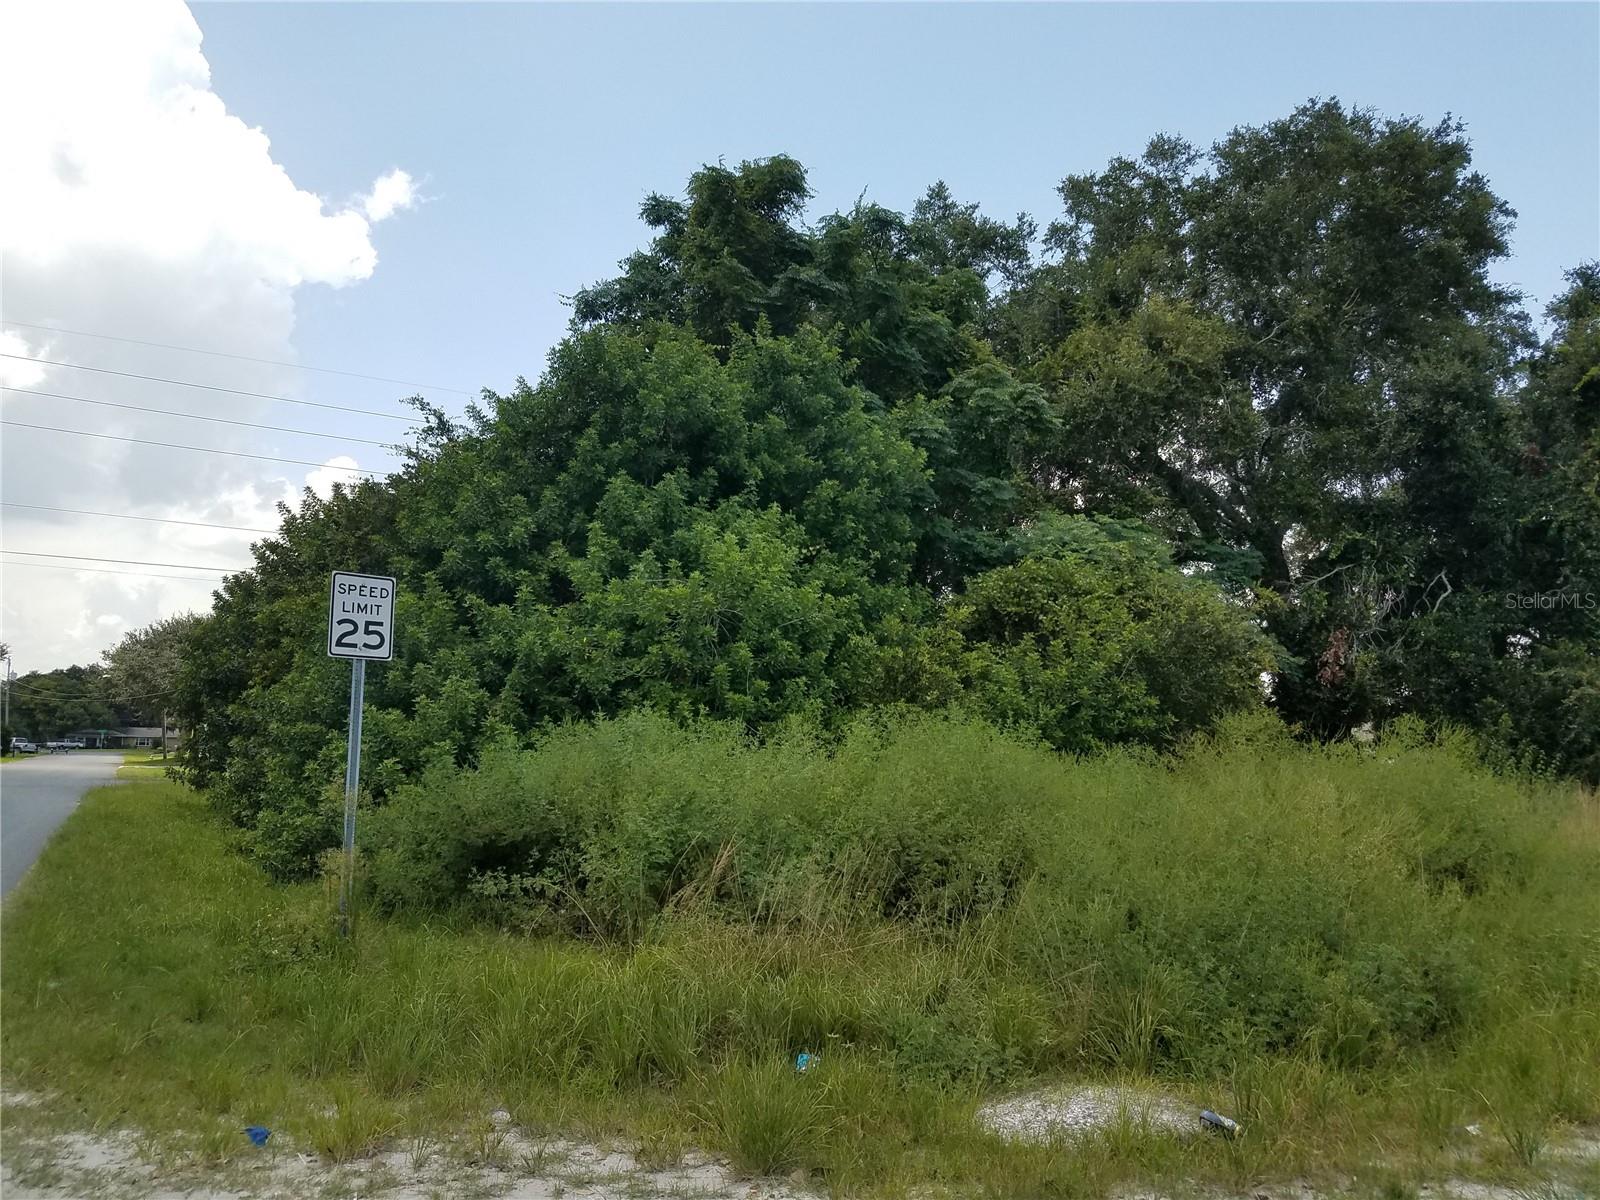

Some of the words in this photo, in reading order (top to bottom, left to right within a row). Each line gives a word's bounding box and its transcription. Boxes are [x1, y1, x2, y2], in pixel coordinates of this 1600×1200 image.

[337, 583, 390, 599] SPEED
[342, 601, 383, 616] LIMIT
[335, 618, 386, 650] 25
